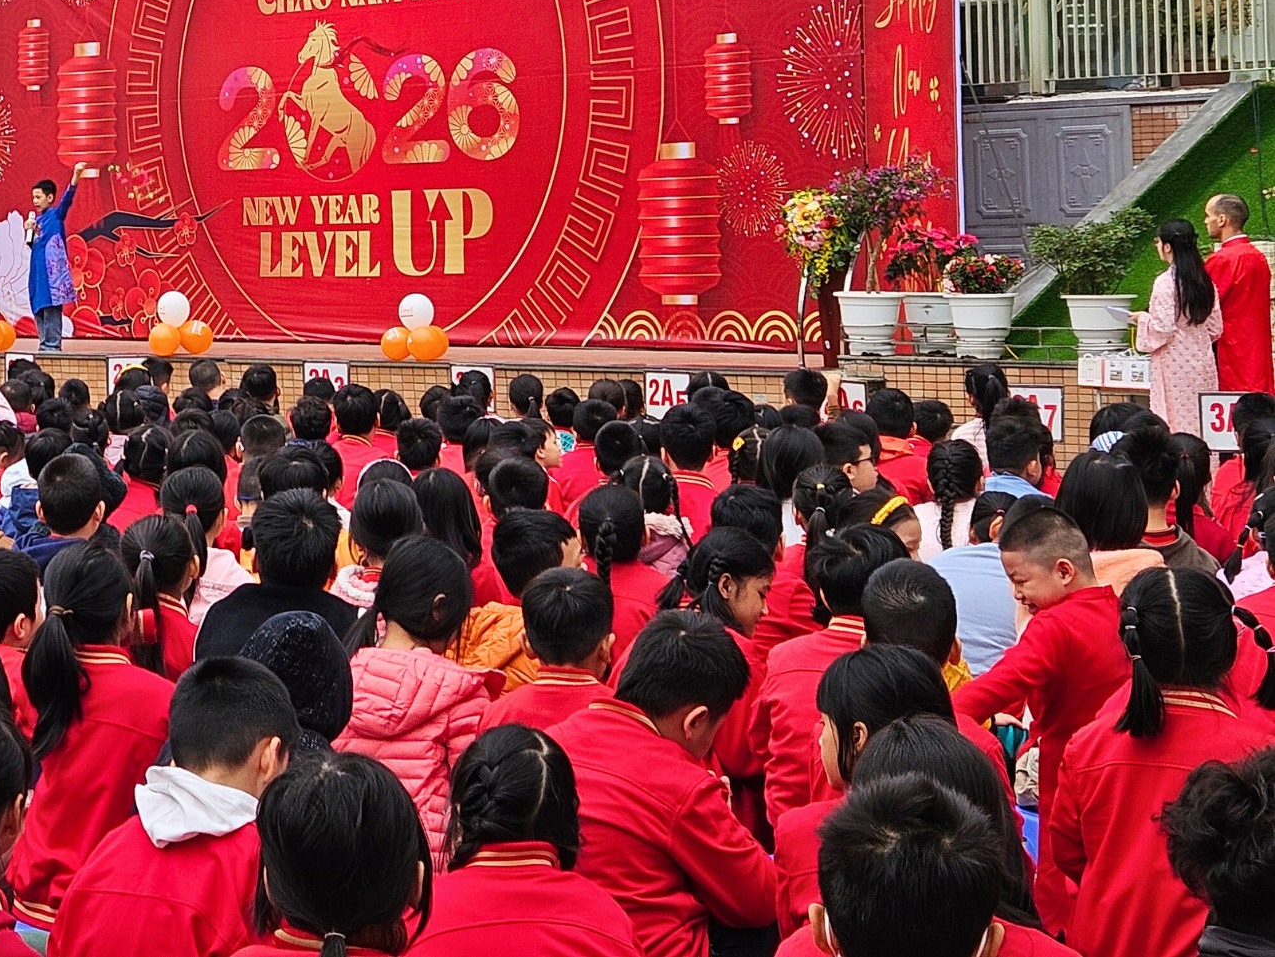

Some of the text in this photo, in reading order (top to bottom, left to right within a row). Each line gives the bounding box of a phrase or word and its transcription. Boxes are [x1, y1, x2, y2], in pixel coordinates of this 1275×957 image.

[893, 44, 923, 119] New
[242, 193, 381, 226] NEW YEAR
[259, 187, 494, 278] LEVEL UP
